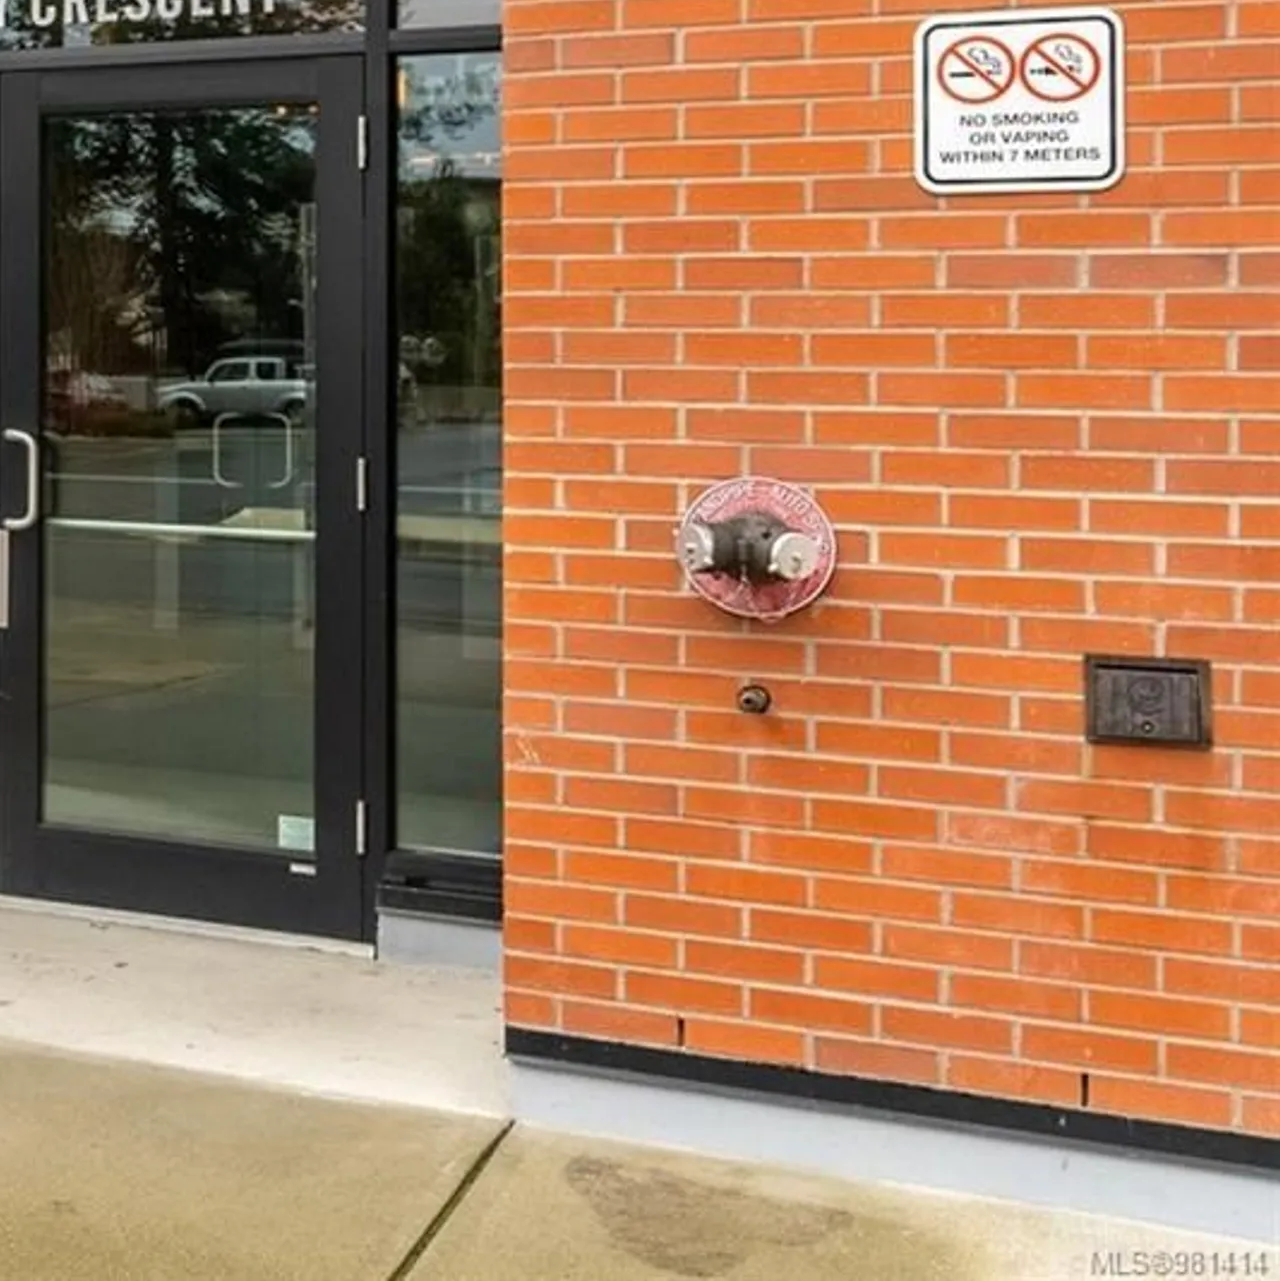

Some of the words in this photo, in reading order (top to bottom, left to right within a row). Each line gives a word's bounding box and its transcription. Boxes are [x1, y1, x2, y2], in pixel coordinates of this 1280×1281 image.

[959, 112, 987, 127] NO
[992, 110, 1080, 127] SMOKING
[969, 131, 997, 145] OR
[1002, 129, 1070, 144] VAPING
[939, 149, 1004, 164] WITHIN
[1011, 148, 1019, 162] 7
[1023, 146, 1101, 162] METERS
